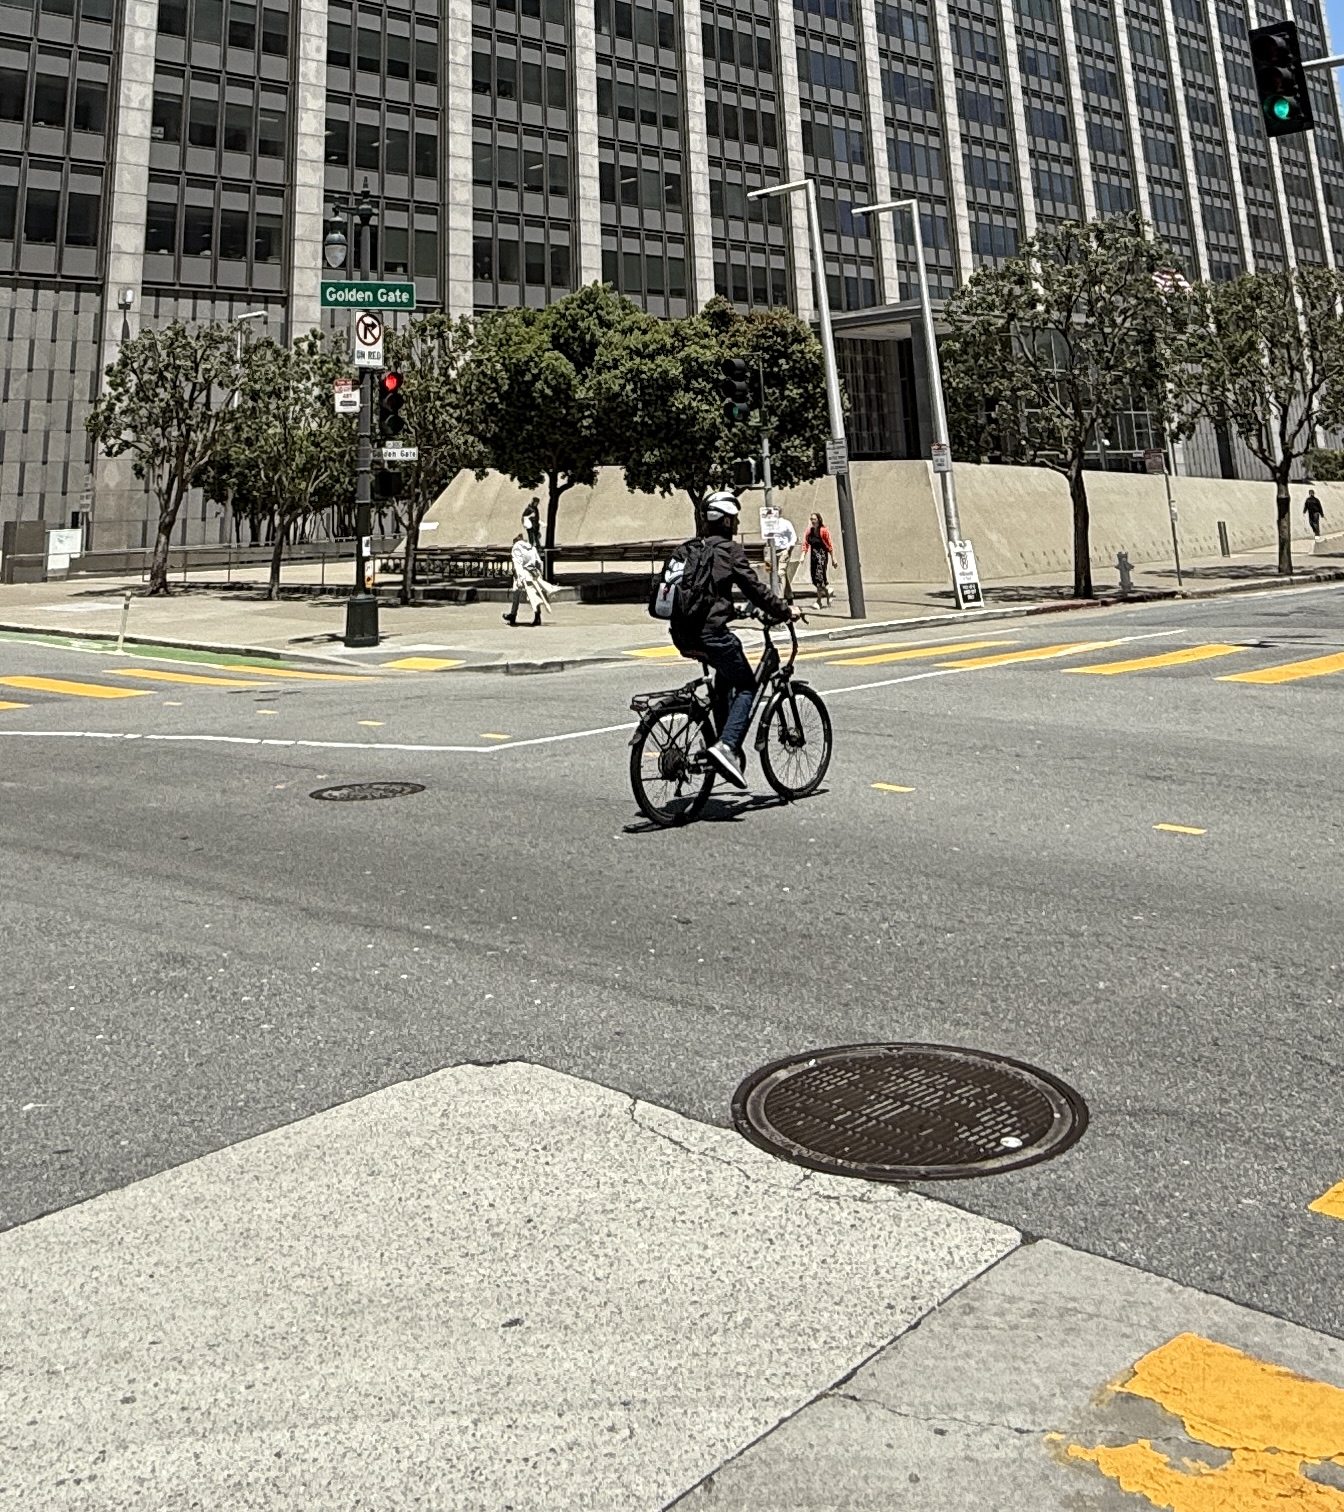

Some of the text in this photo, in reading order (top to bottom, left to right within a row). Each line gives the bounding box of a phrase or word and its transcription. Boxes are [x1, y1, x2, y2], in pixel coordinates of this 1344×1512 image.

[325, 287, 410, 304] Golden Gate
[356, 349, 382, 361] ON RED
